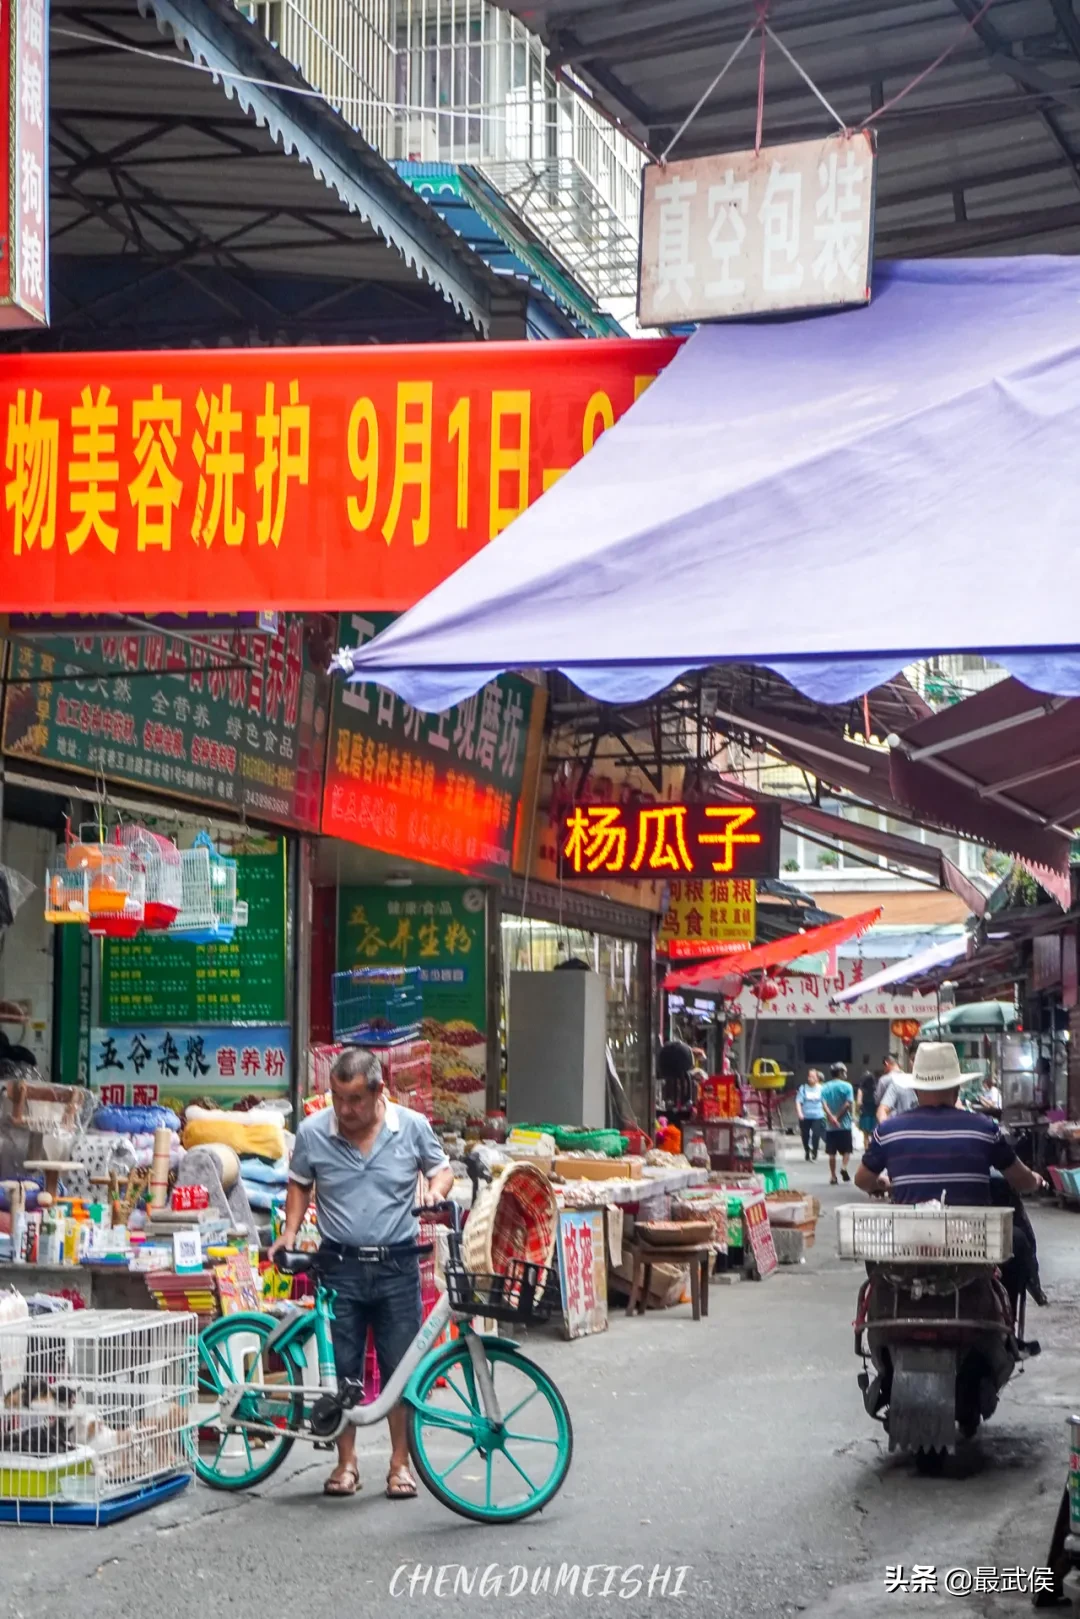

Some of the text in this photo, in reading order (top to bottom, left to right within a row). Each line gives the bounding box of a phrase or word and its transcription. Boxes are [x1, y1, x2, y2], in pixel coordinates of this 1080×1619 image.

[22, 149, 43, 300] 狗粮
[654, 151, 865, 311] 真空包装
[5, 380, 311, 557] 物美容洗护
[564, 806, 761, 873] 杨瓜子
[662, 906, 704, 937] 鸟食
[96, 1031, 287, 1079] 五谷杂粮 营养粉
